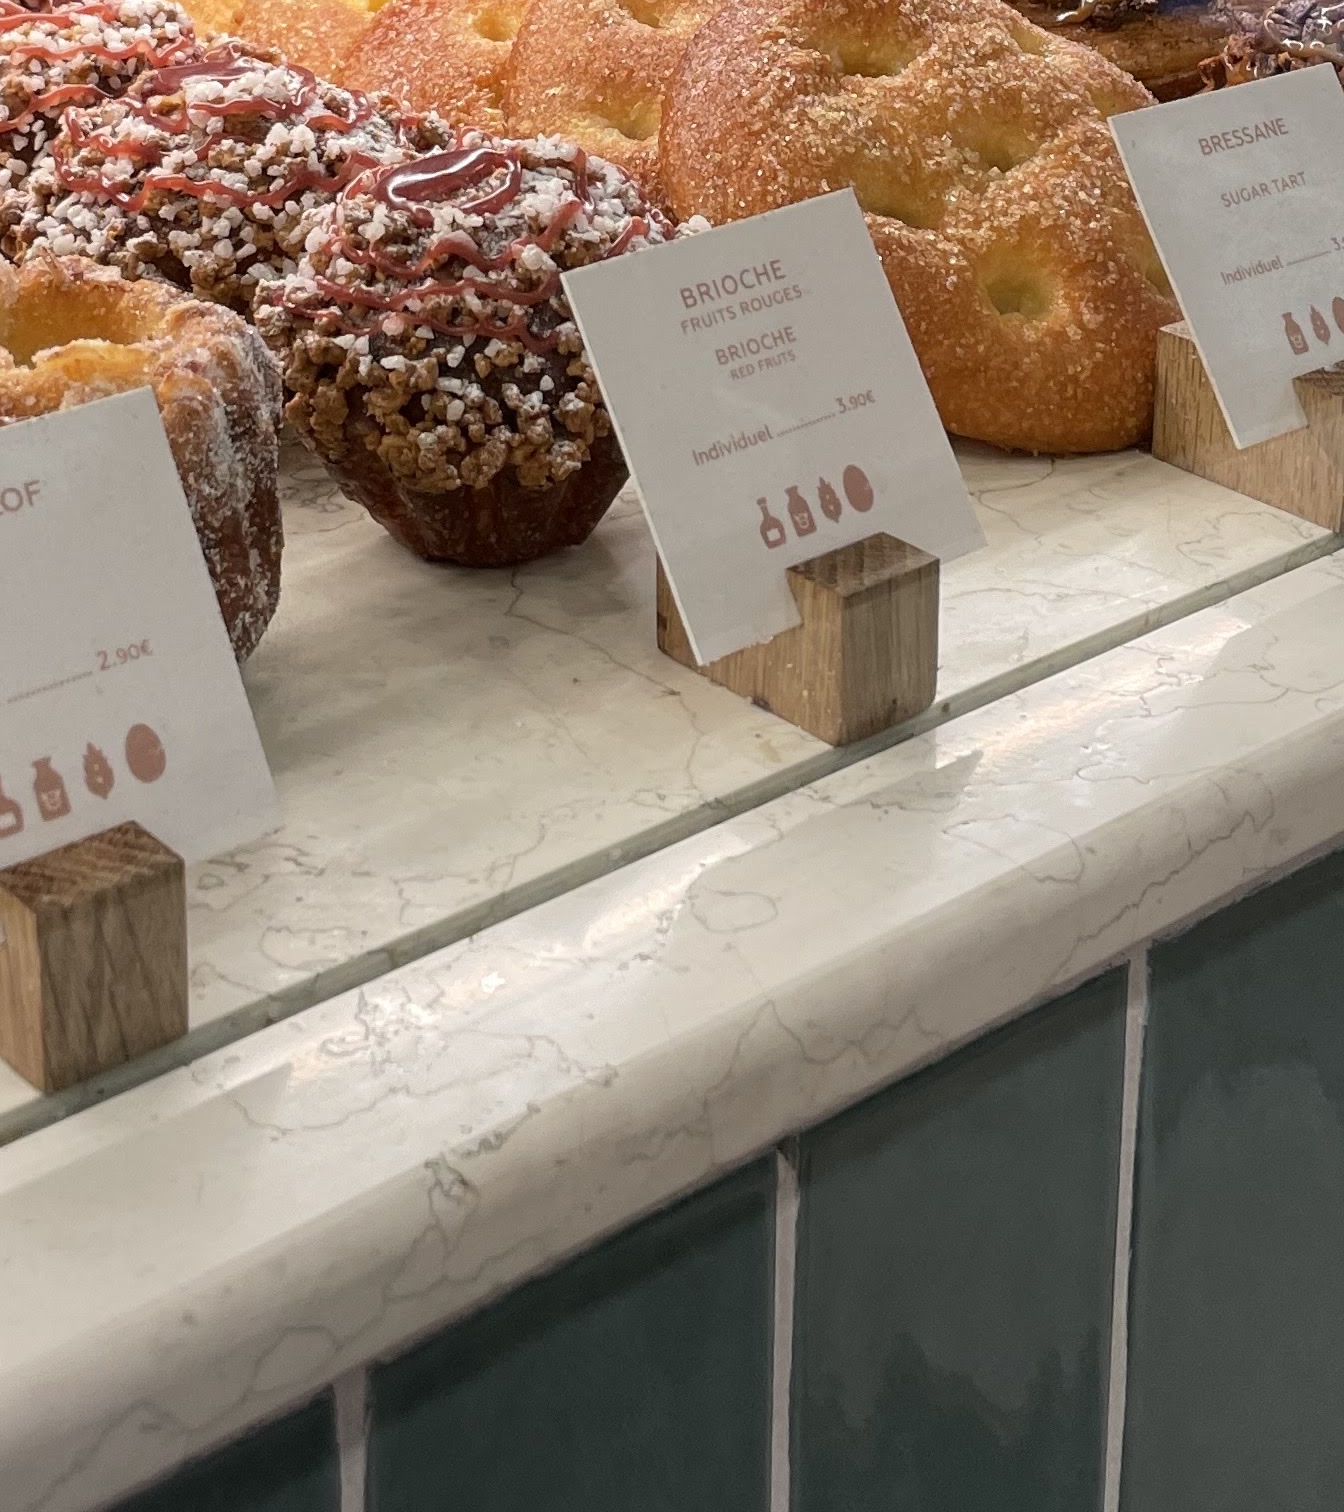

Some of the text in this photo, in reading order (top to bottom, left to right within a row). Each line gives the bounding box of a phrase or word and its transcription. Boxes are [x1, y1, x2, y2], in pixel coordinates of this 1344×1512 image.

[1197, 117, 1290, 157] BRESSANE
[1219, 171, 1307, 209] SUGAR TART
[678, 259, 788, 310] BRIOCHE
[1219, 254, 1285, 286] Individuel
[679, 284, 804, 336] FRUITS ROUGES
[714, 326, 798, 367] BRIOCHE
[729, 362, 757, 382] RED
[691, 424, 775, 467] Individuel
[94, 638, 155, 674] 2.90€
